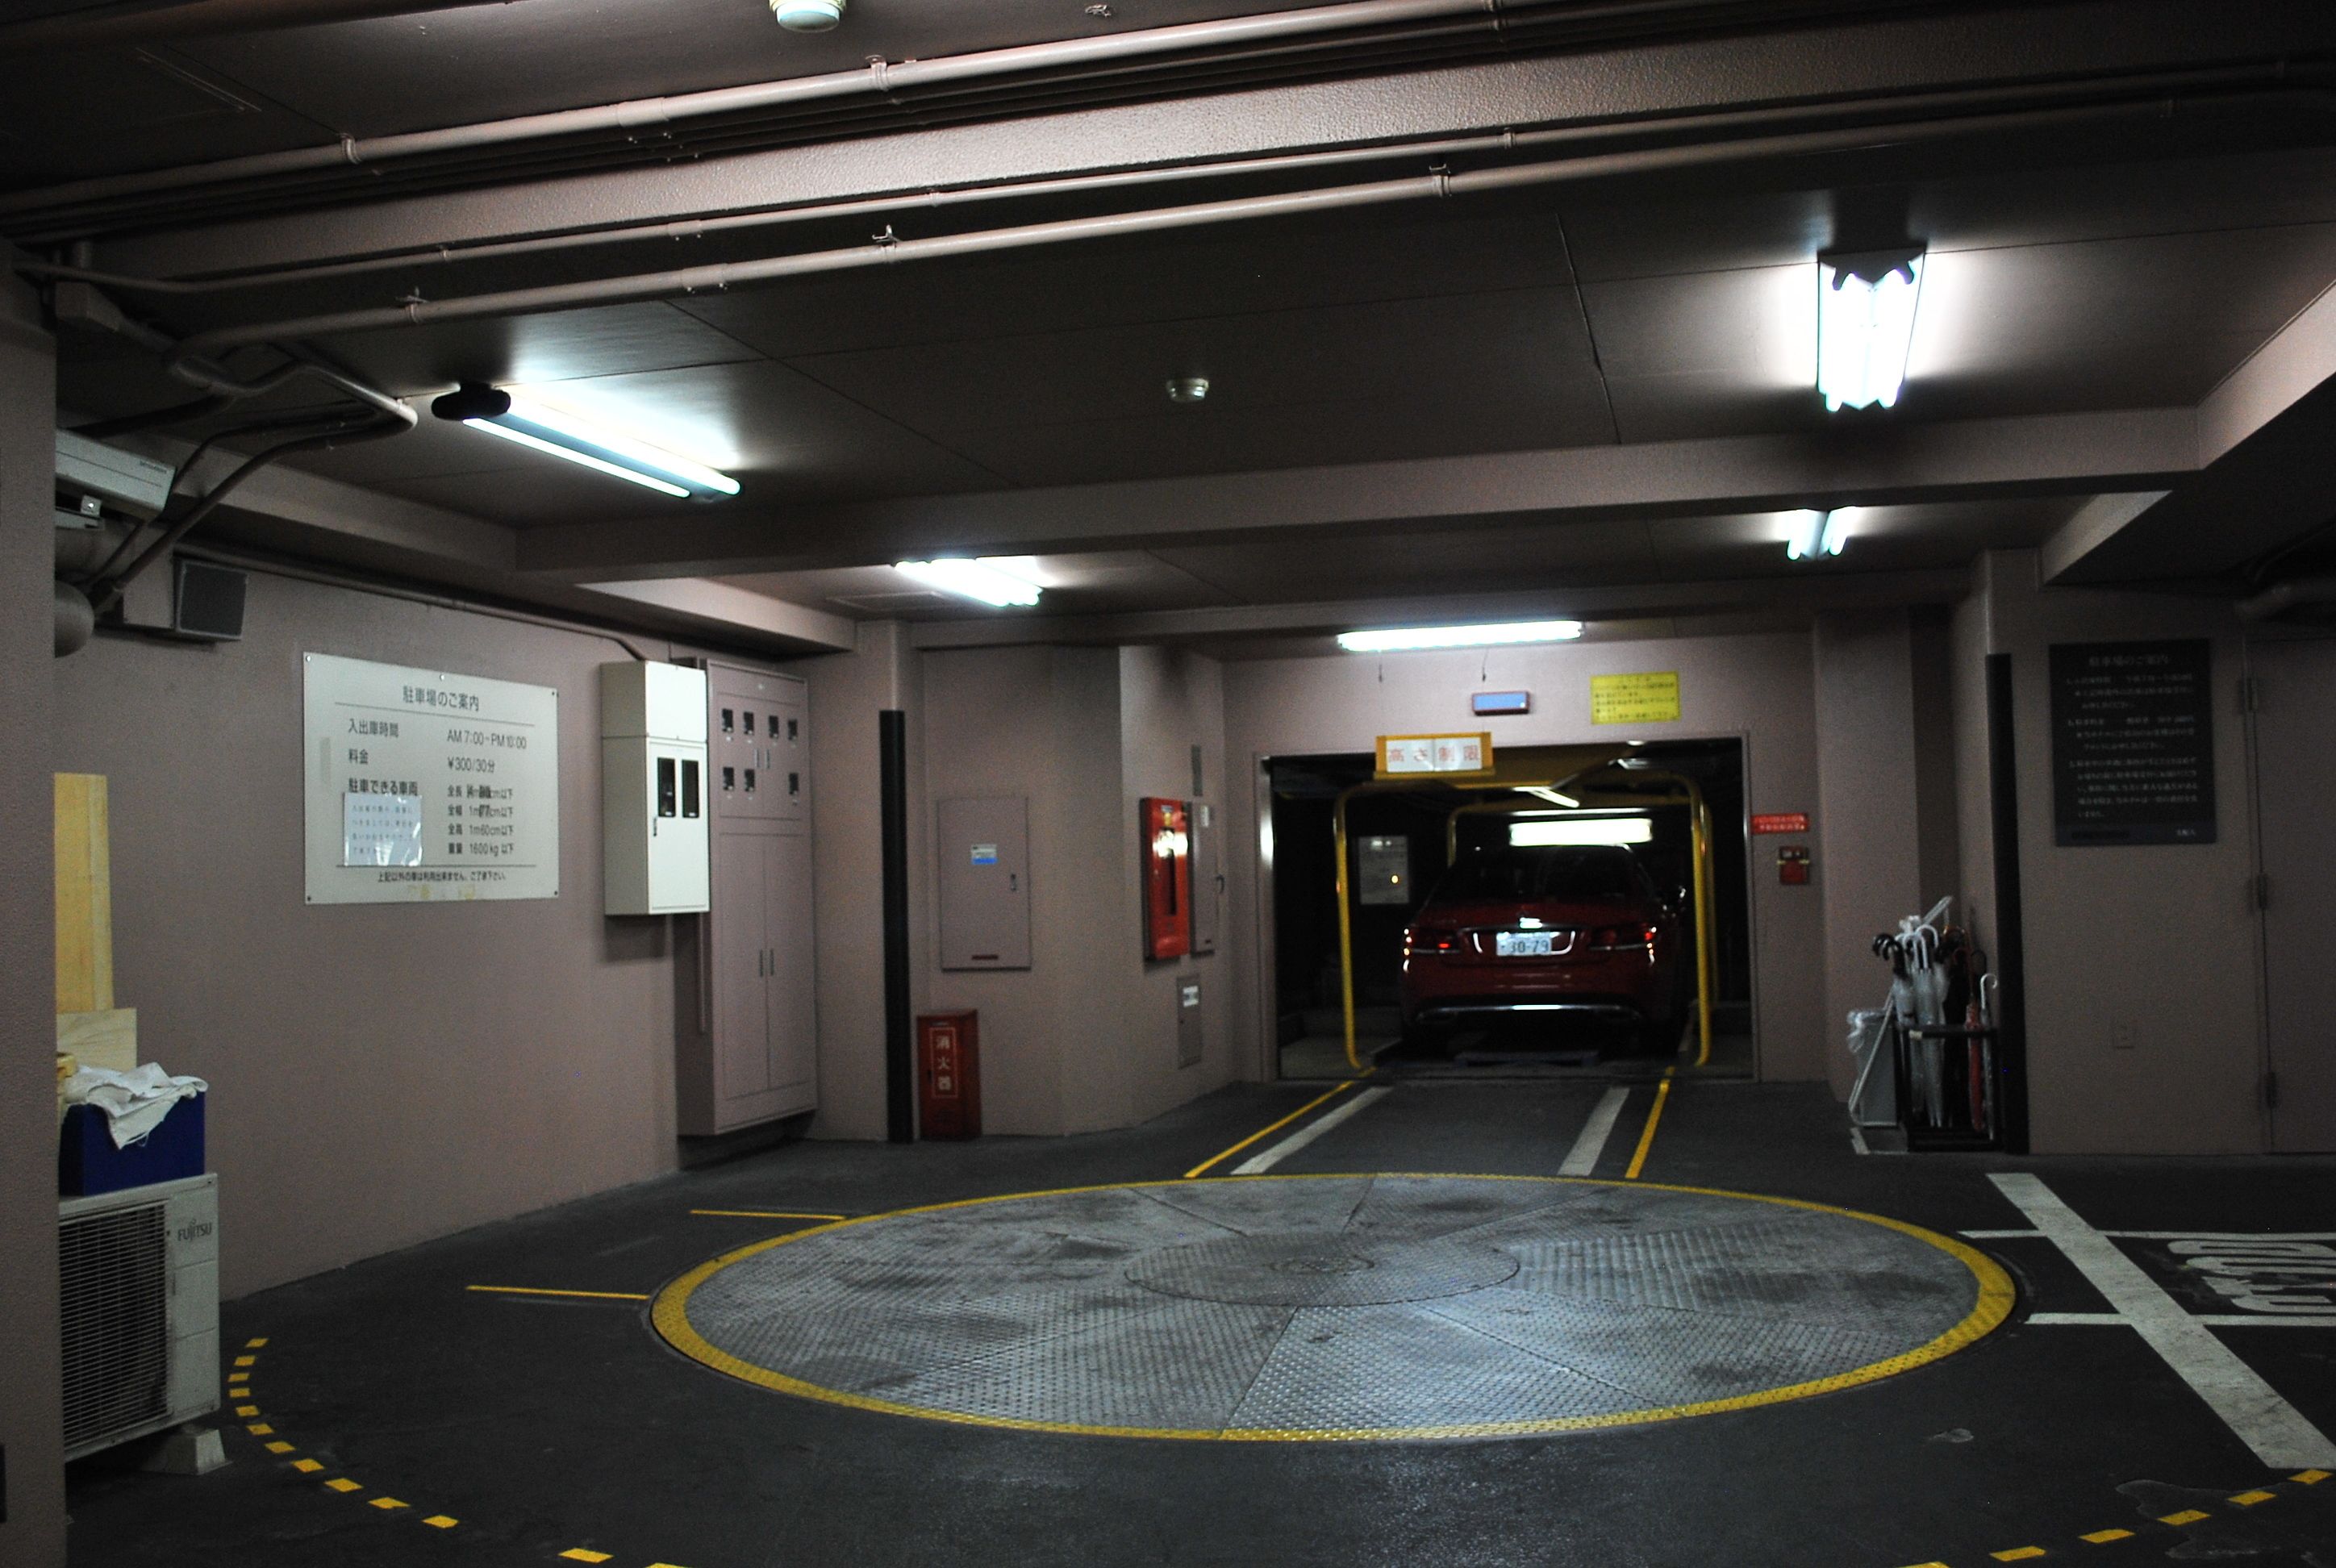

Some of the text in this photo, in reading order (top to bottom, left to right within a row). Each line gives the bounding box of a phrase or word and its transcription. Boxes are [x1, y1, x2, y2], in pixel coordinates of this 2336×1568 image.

[403, 686, 480, 711] 駐車場のご案内
[348, 718, 399, 738] 入出庫時間
[348, 749, 369, 765] 料金
[1388, 744, 1479, 762] 高さ制限
[177, 1220, 213, 1242] FUJITSU
